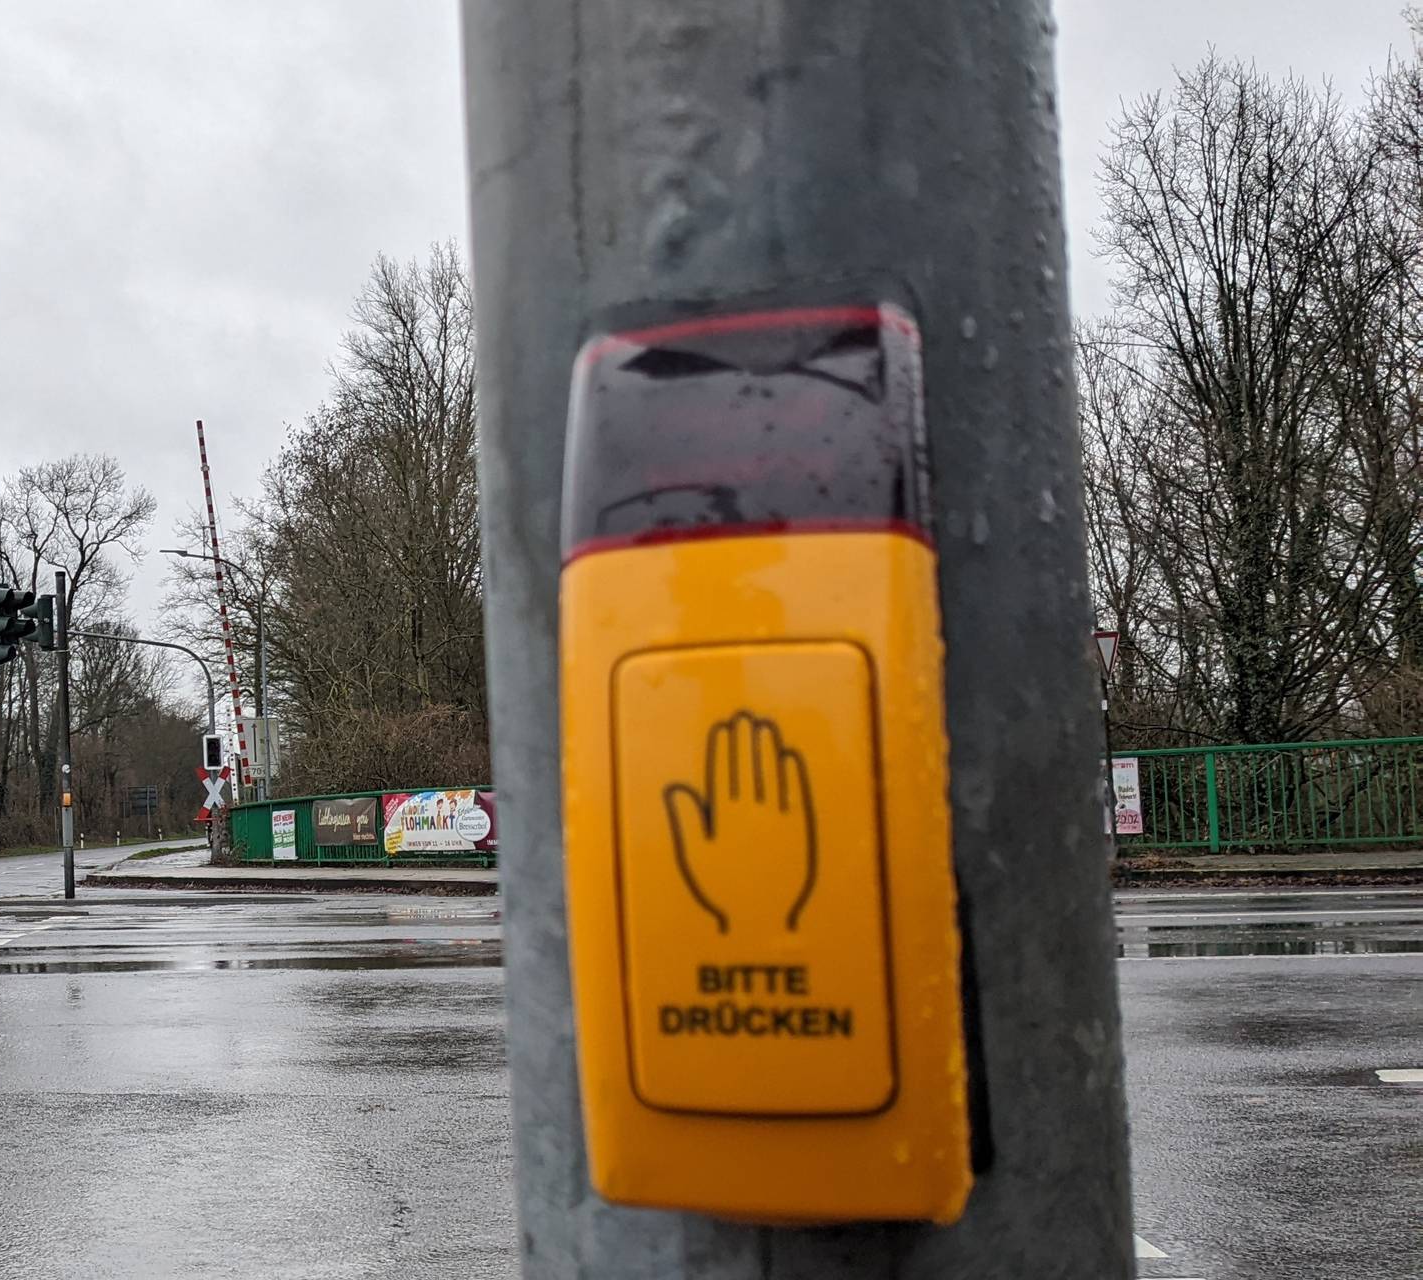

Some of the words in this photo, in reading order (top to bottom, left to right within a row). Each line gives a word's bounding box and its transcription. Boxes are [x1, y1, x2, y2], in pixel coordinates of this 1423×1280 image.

[400, 814, 456, 831] FLOHMARKT
[698, 964, 810, 995] BITTE
[658, 1002, 855, 1037] DRÜCKEN
